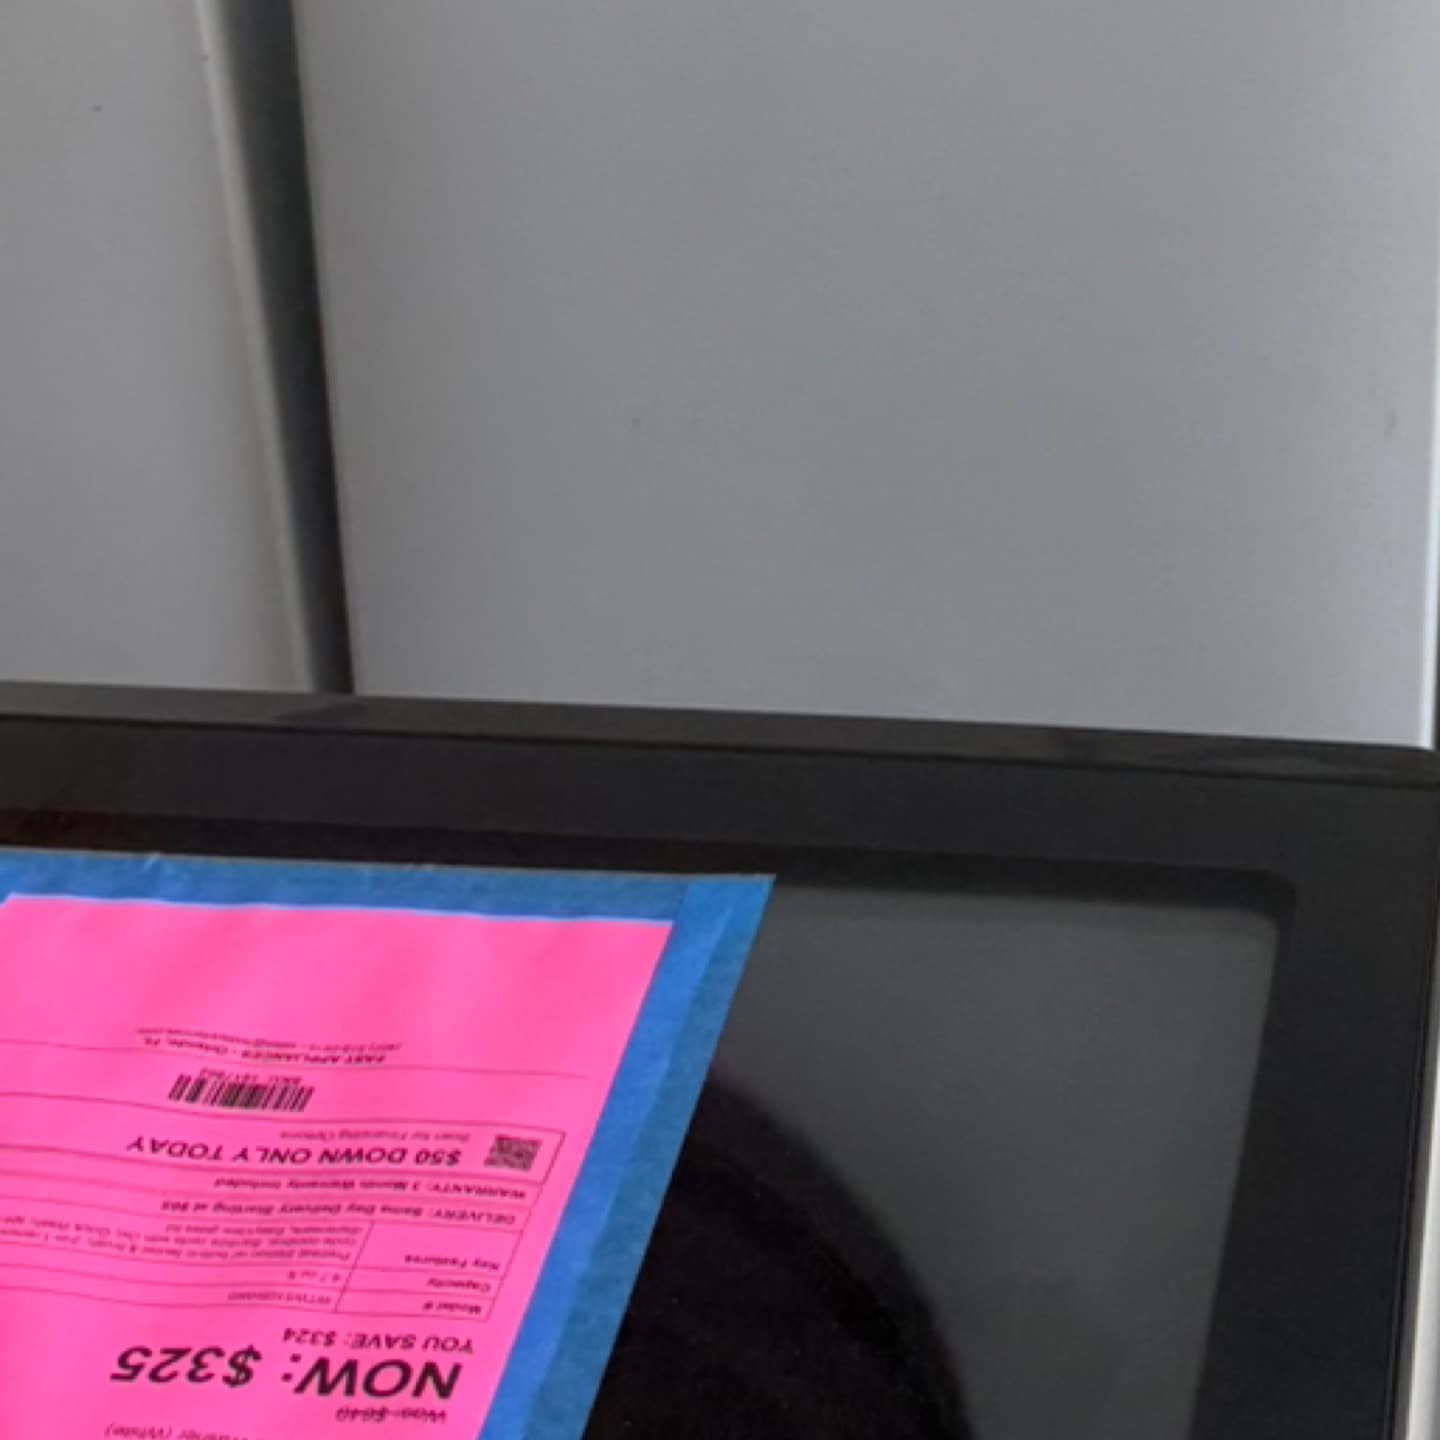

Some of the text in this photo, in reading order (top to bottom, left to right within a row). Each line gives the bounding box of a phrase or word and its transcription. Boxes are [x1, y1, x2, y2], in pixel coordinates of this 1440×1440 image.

[126, 1136, 461, 1167] $50 DOWN ONLY TODAY
[430, 1208, 516, 1226] DELIVERY:
[427, 1277, 491, 1293] Capacity
[283, 1328, 473, 1354] YOU SAVE: $324
[110, 1345, 462, 1400] NOW: $325
